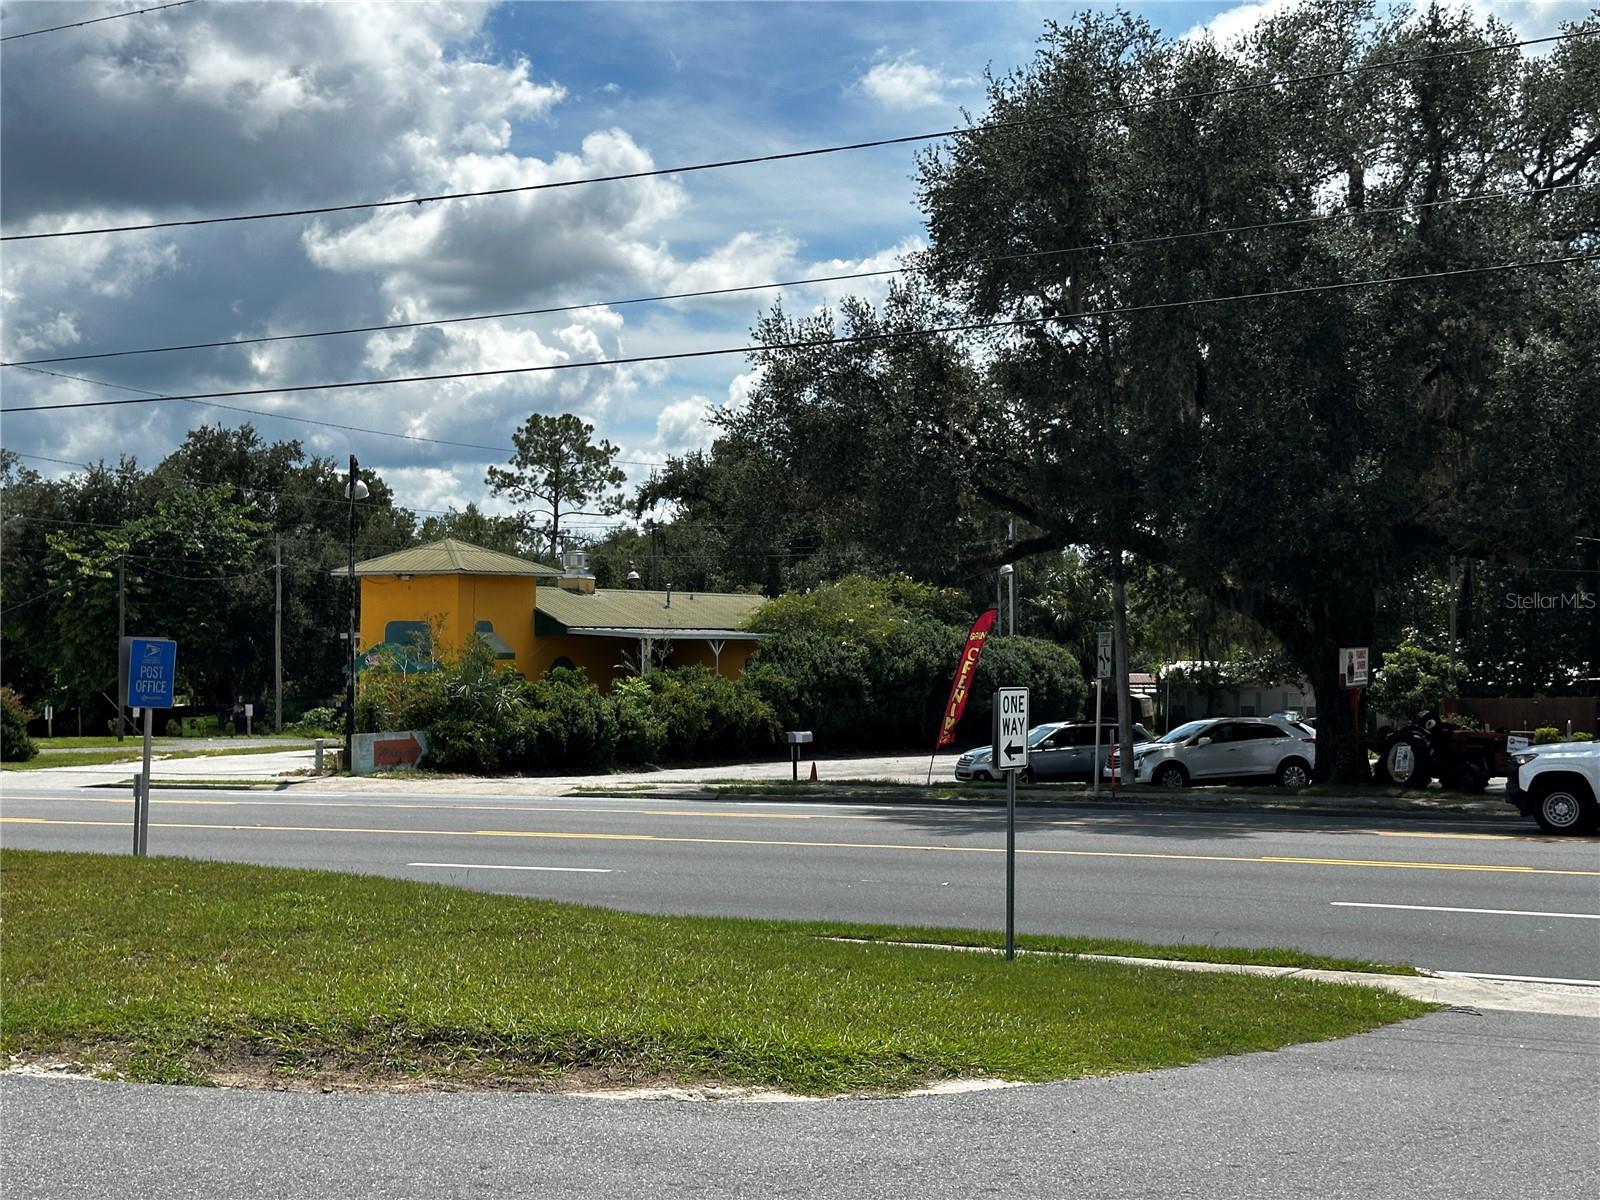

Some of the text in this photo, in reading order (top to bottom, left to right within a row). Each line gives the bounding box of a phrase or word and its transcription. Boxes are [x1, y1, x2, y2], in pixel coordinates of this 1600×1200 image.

[140, 665, 164, 679] POST
[135, 679, 167, 694] OFFICE
[1003, 695, 1024, 714] ONE
[1002, 717, 1025, 736] WAY
